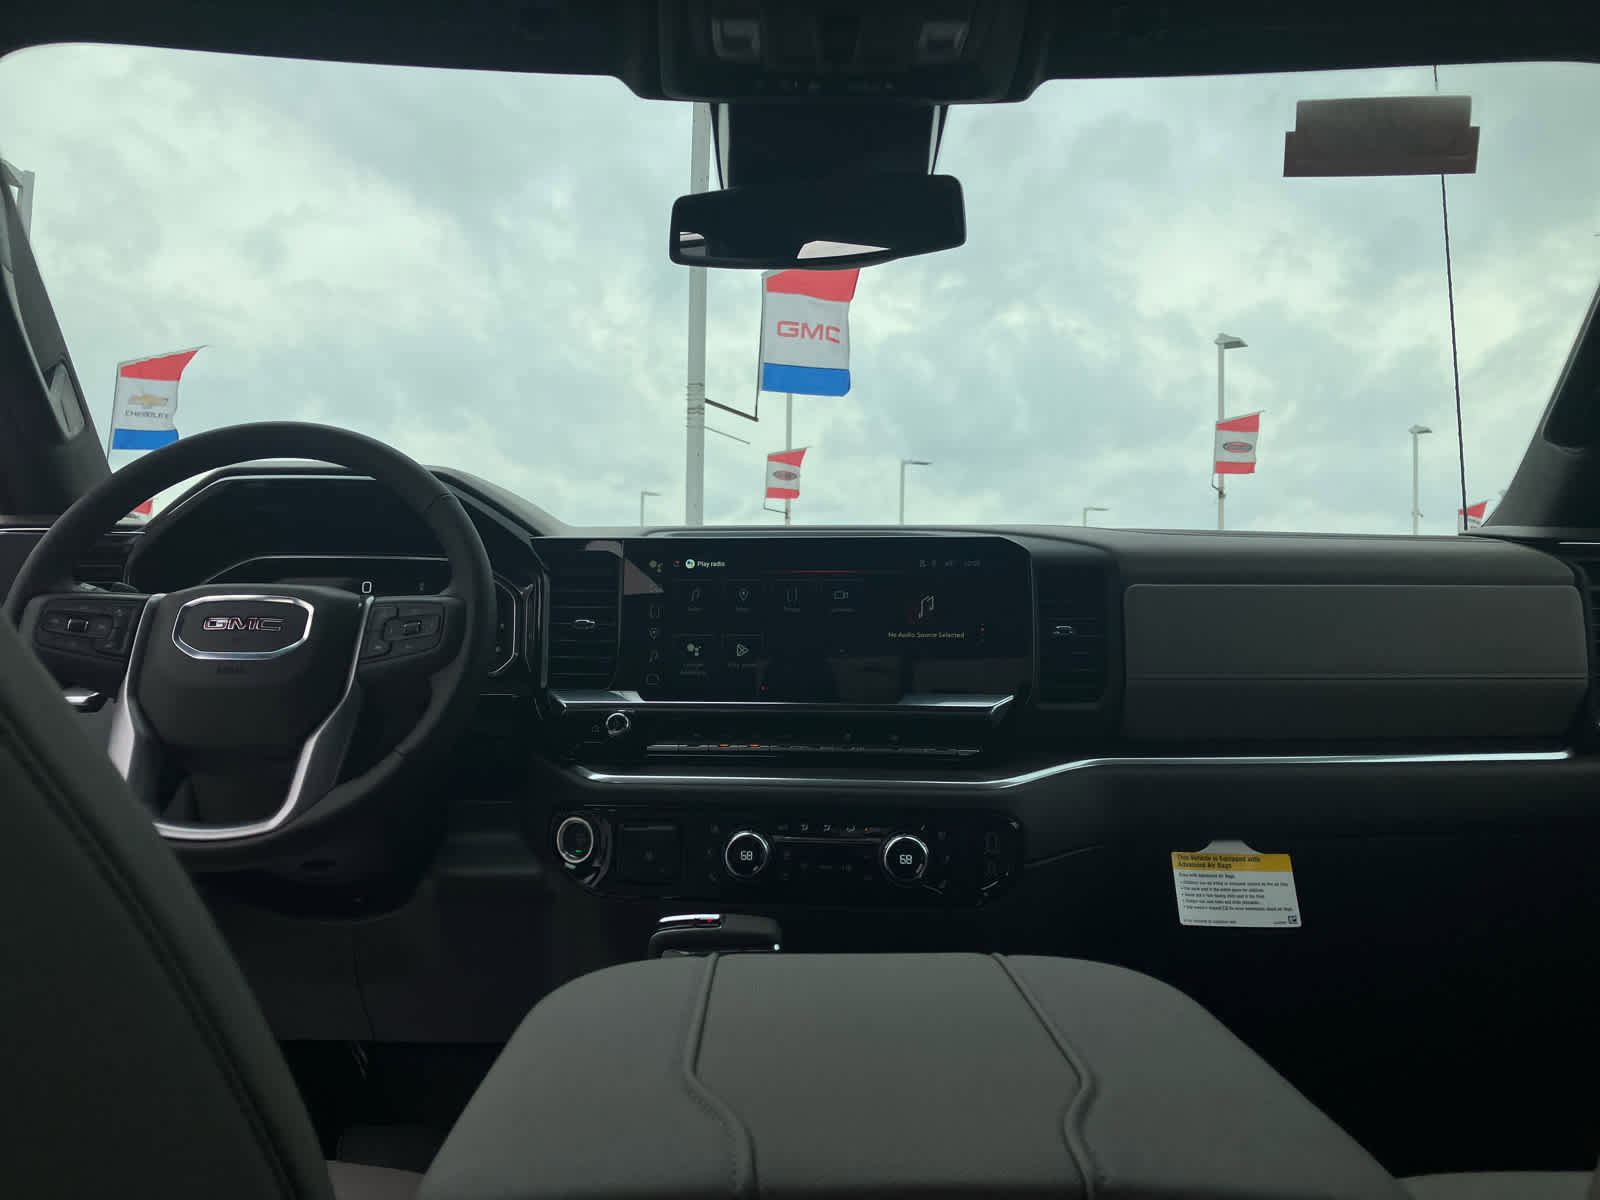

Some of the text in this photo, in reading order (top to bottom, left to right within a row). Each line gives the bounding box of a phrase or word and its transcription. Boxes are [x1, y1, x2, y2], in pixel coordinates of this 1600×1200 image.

[777, 320, 841, 344] GMC
[697, 560, 710, 569] Play
[203, 617, 285, 631] GMC
[740, 850, 753, 861] 68
[899, 854, 913, 865] 68
